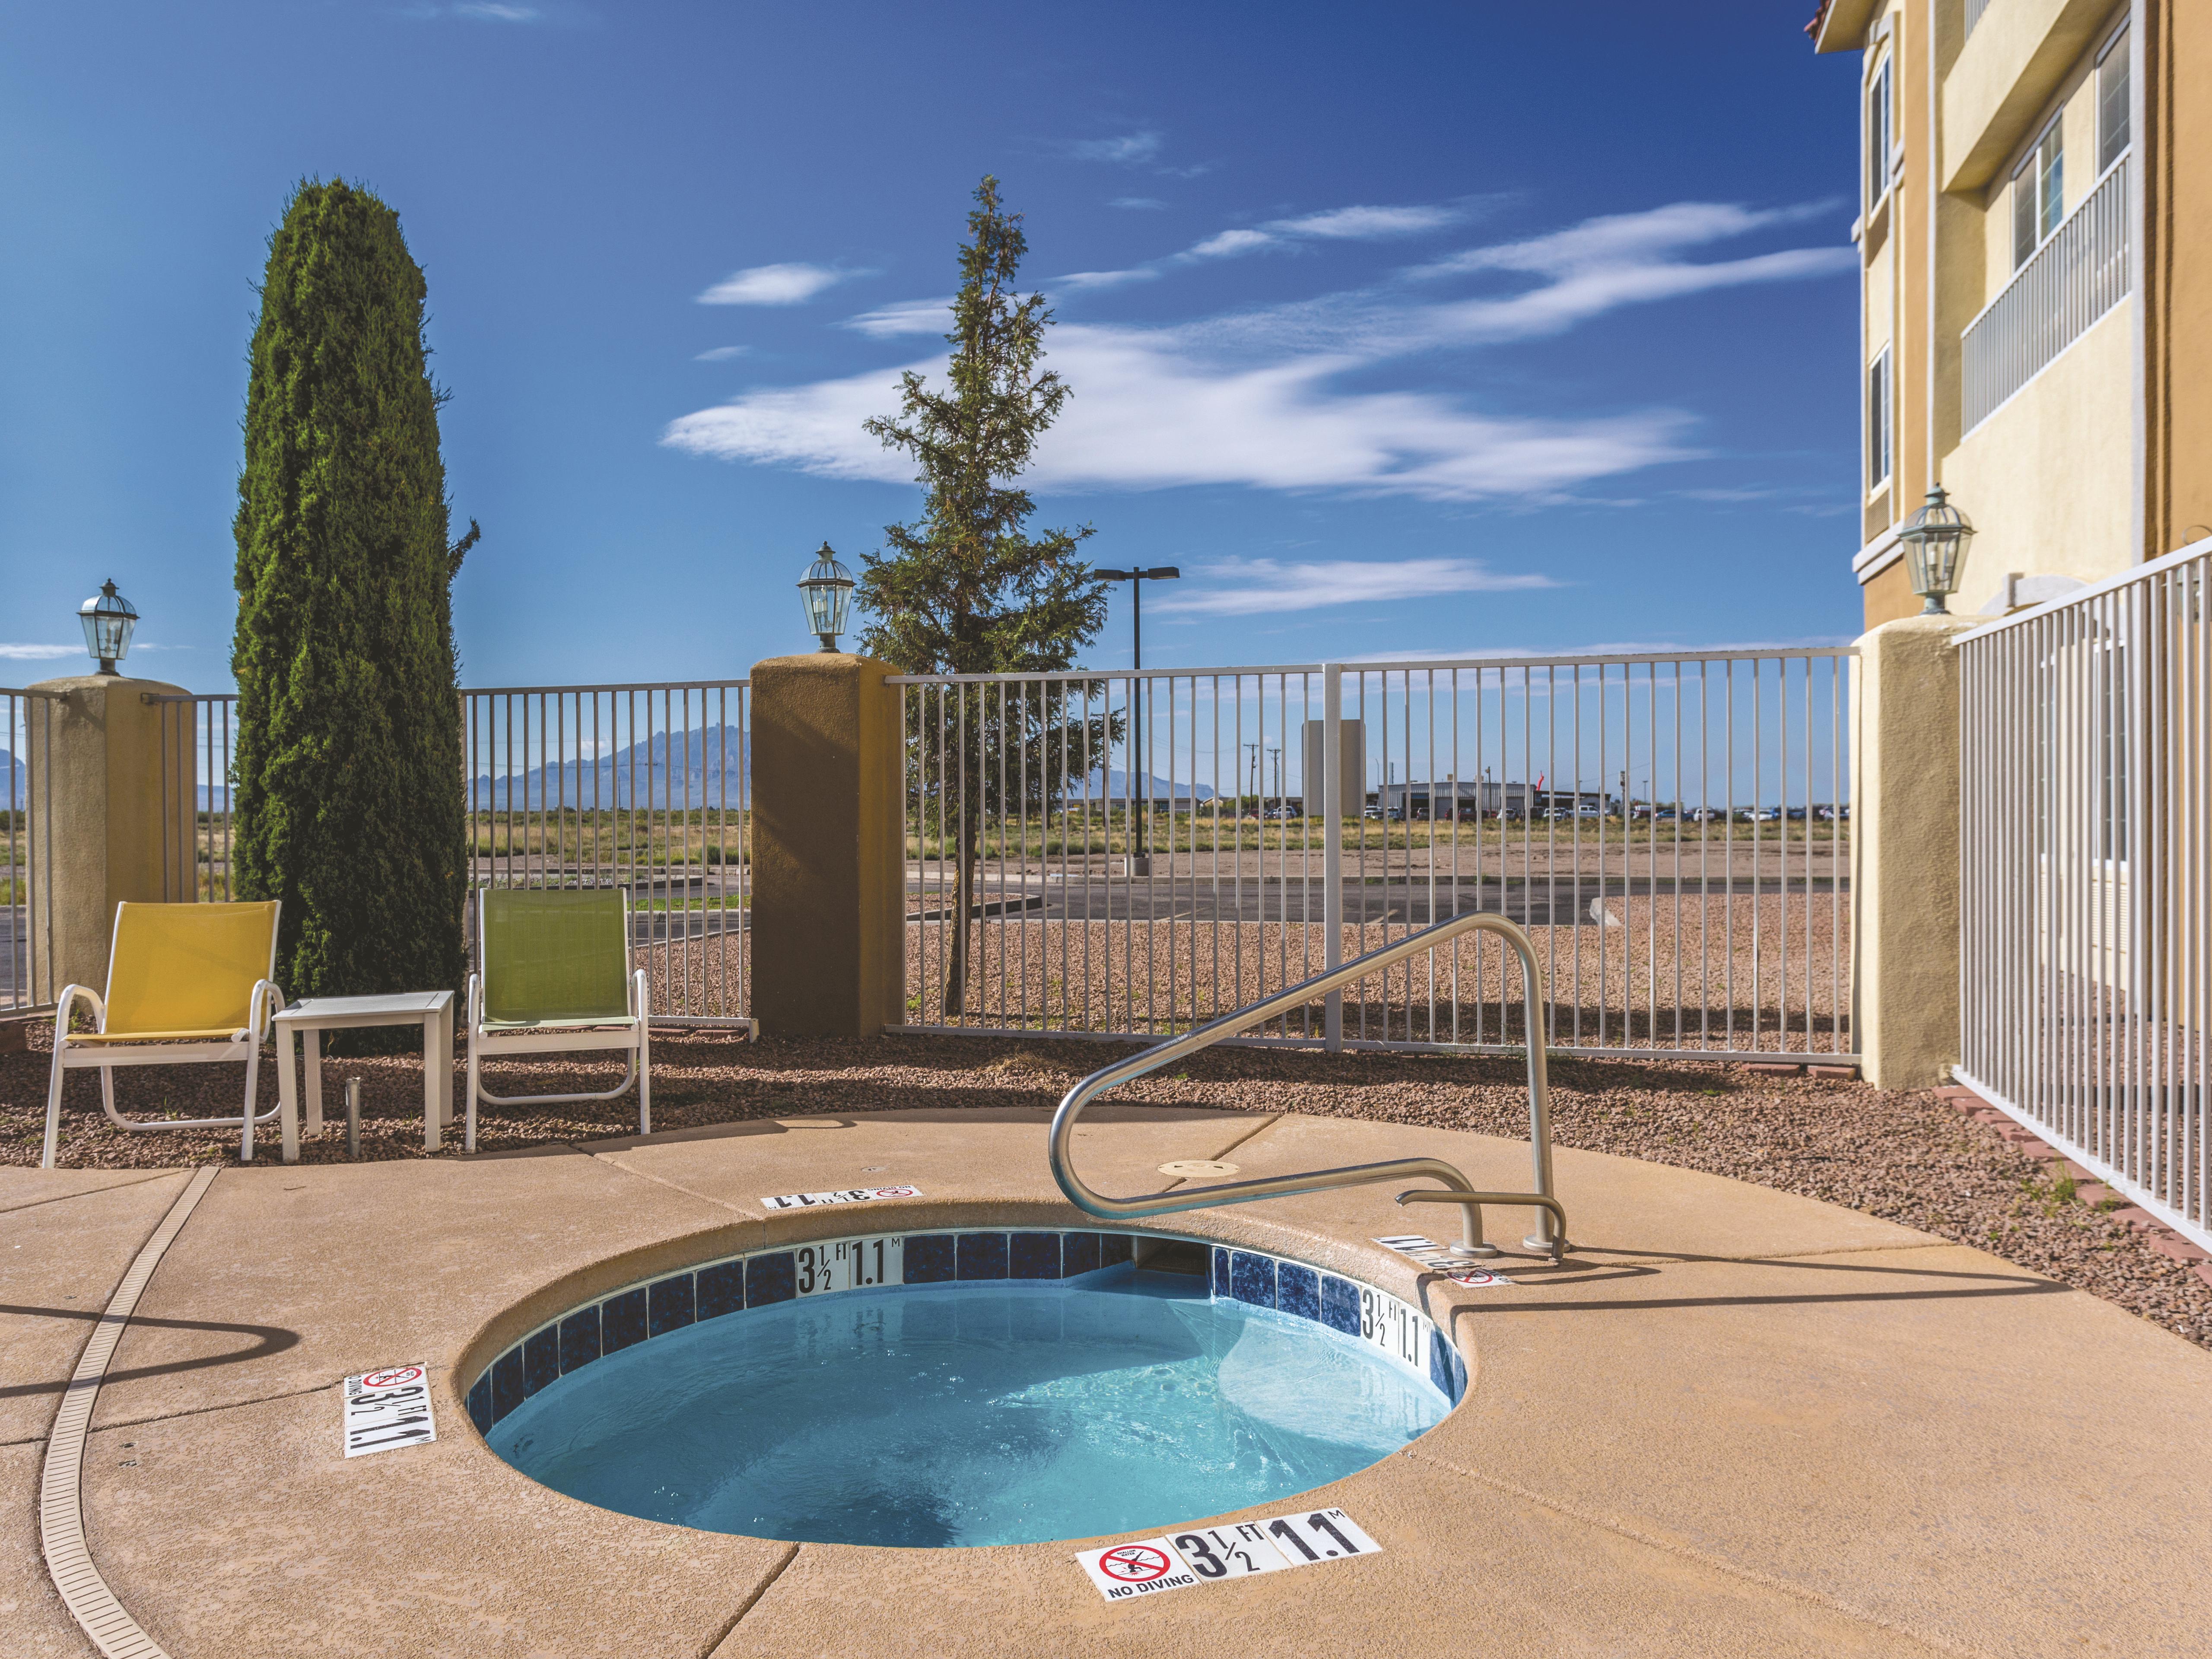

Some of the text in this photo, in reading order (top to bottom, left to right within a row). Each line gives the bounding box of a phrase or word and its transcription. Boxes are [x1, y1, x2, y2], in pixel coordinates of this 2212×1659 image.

[774, 1195, 816, 1208] 1.1
[1380, 1238, 1438, 1251] 1.1
[836, 1242, 847, 1261] FT
[852, 1239, 884, 1286] 1.1
[892, 1238, 900, 1247] M
[1401, 1309, 1418, 1367] 1.1
[348, 1379, 362, 1395] DIVING
[397, 1405, 427, 1416] FT
[350, 1416, 430, 1449] 1.1
[1235, 1523, 1265, 1542] FT
[1268, 1513, 1360, 1561] 1.1
[1327, 1510, 1345, 1519] M
[1107, 1574, 1194, 1598] NO DIVING
